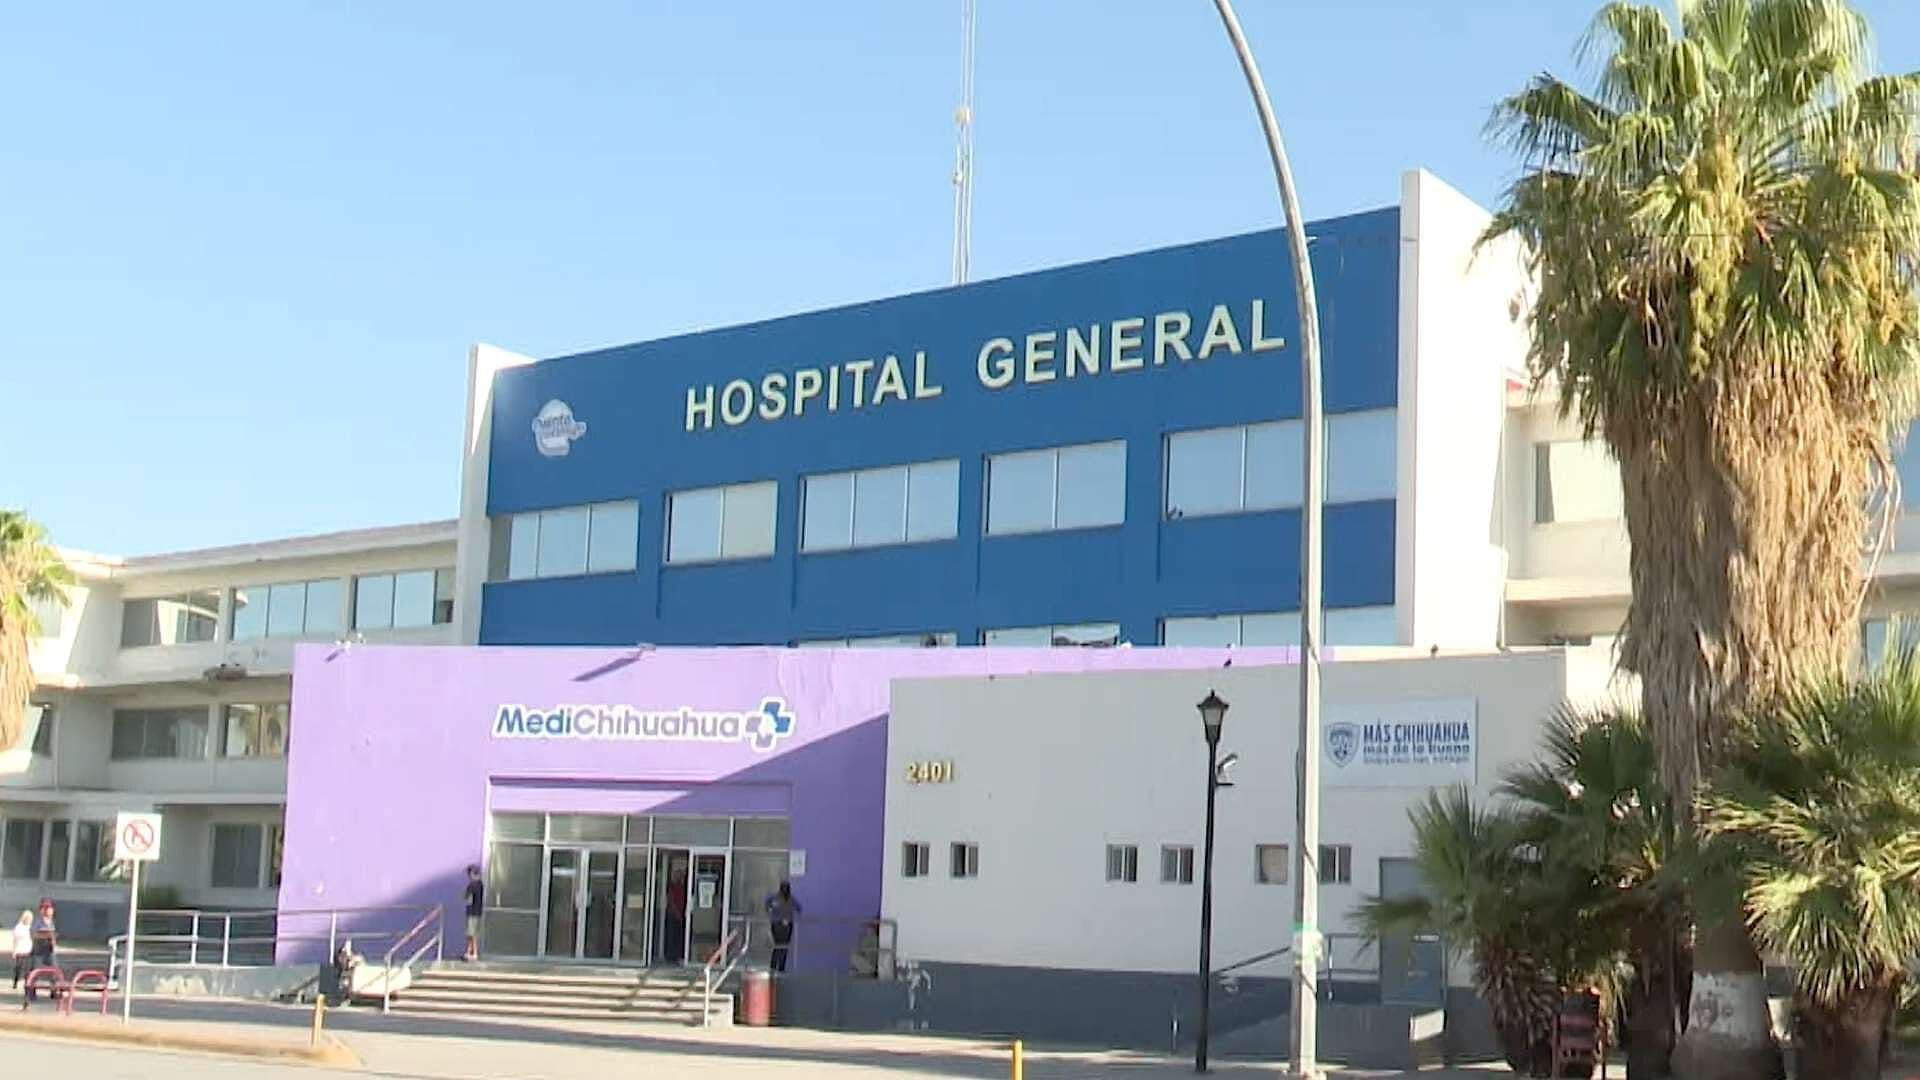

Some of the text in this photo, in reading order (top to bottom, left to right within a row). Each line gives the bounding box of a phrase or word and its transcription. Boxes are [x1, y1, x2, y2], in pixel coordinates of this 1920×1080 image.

[685, 299, 1286, 432] HOSPITAL GENERAL
[496, 704, 740, 740] MediChihuahua
[1363, 717, 1469, 743] MÁS CHIHUAHUA
[904, 761, 953, 784] 2401
